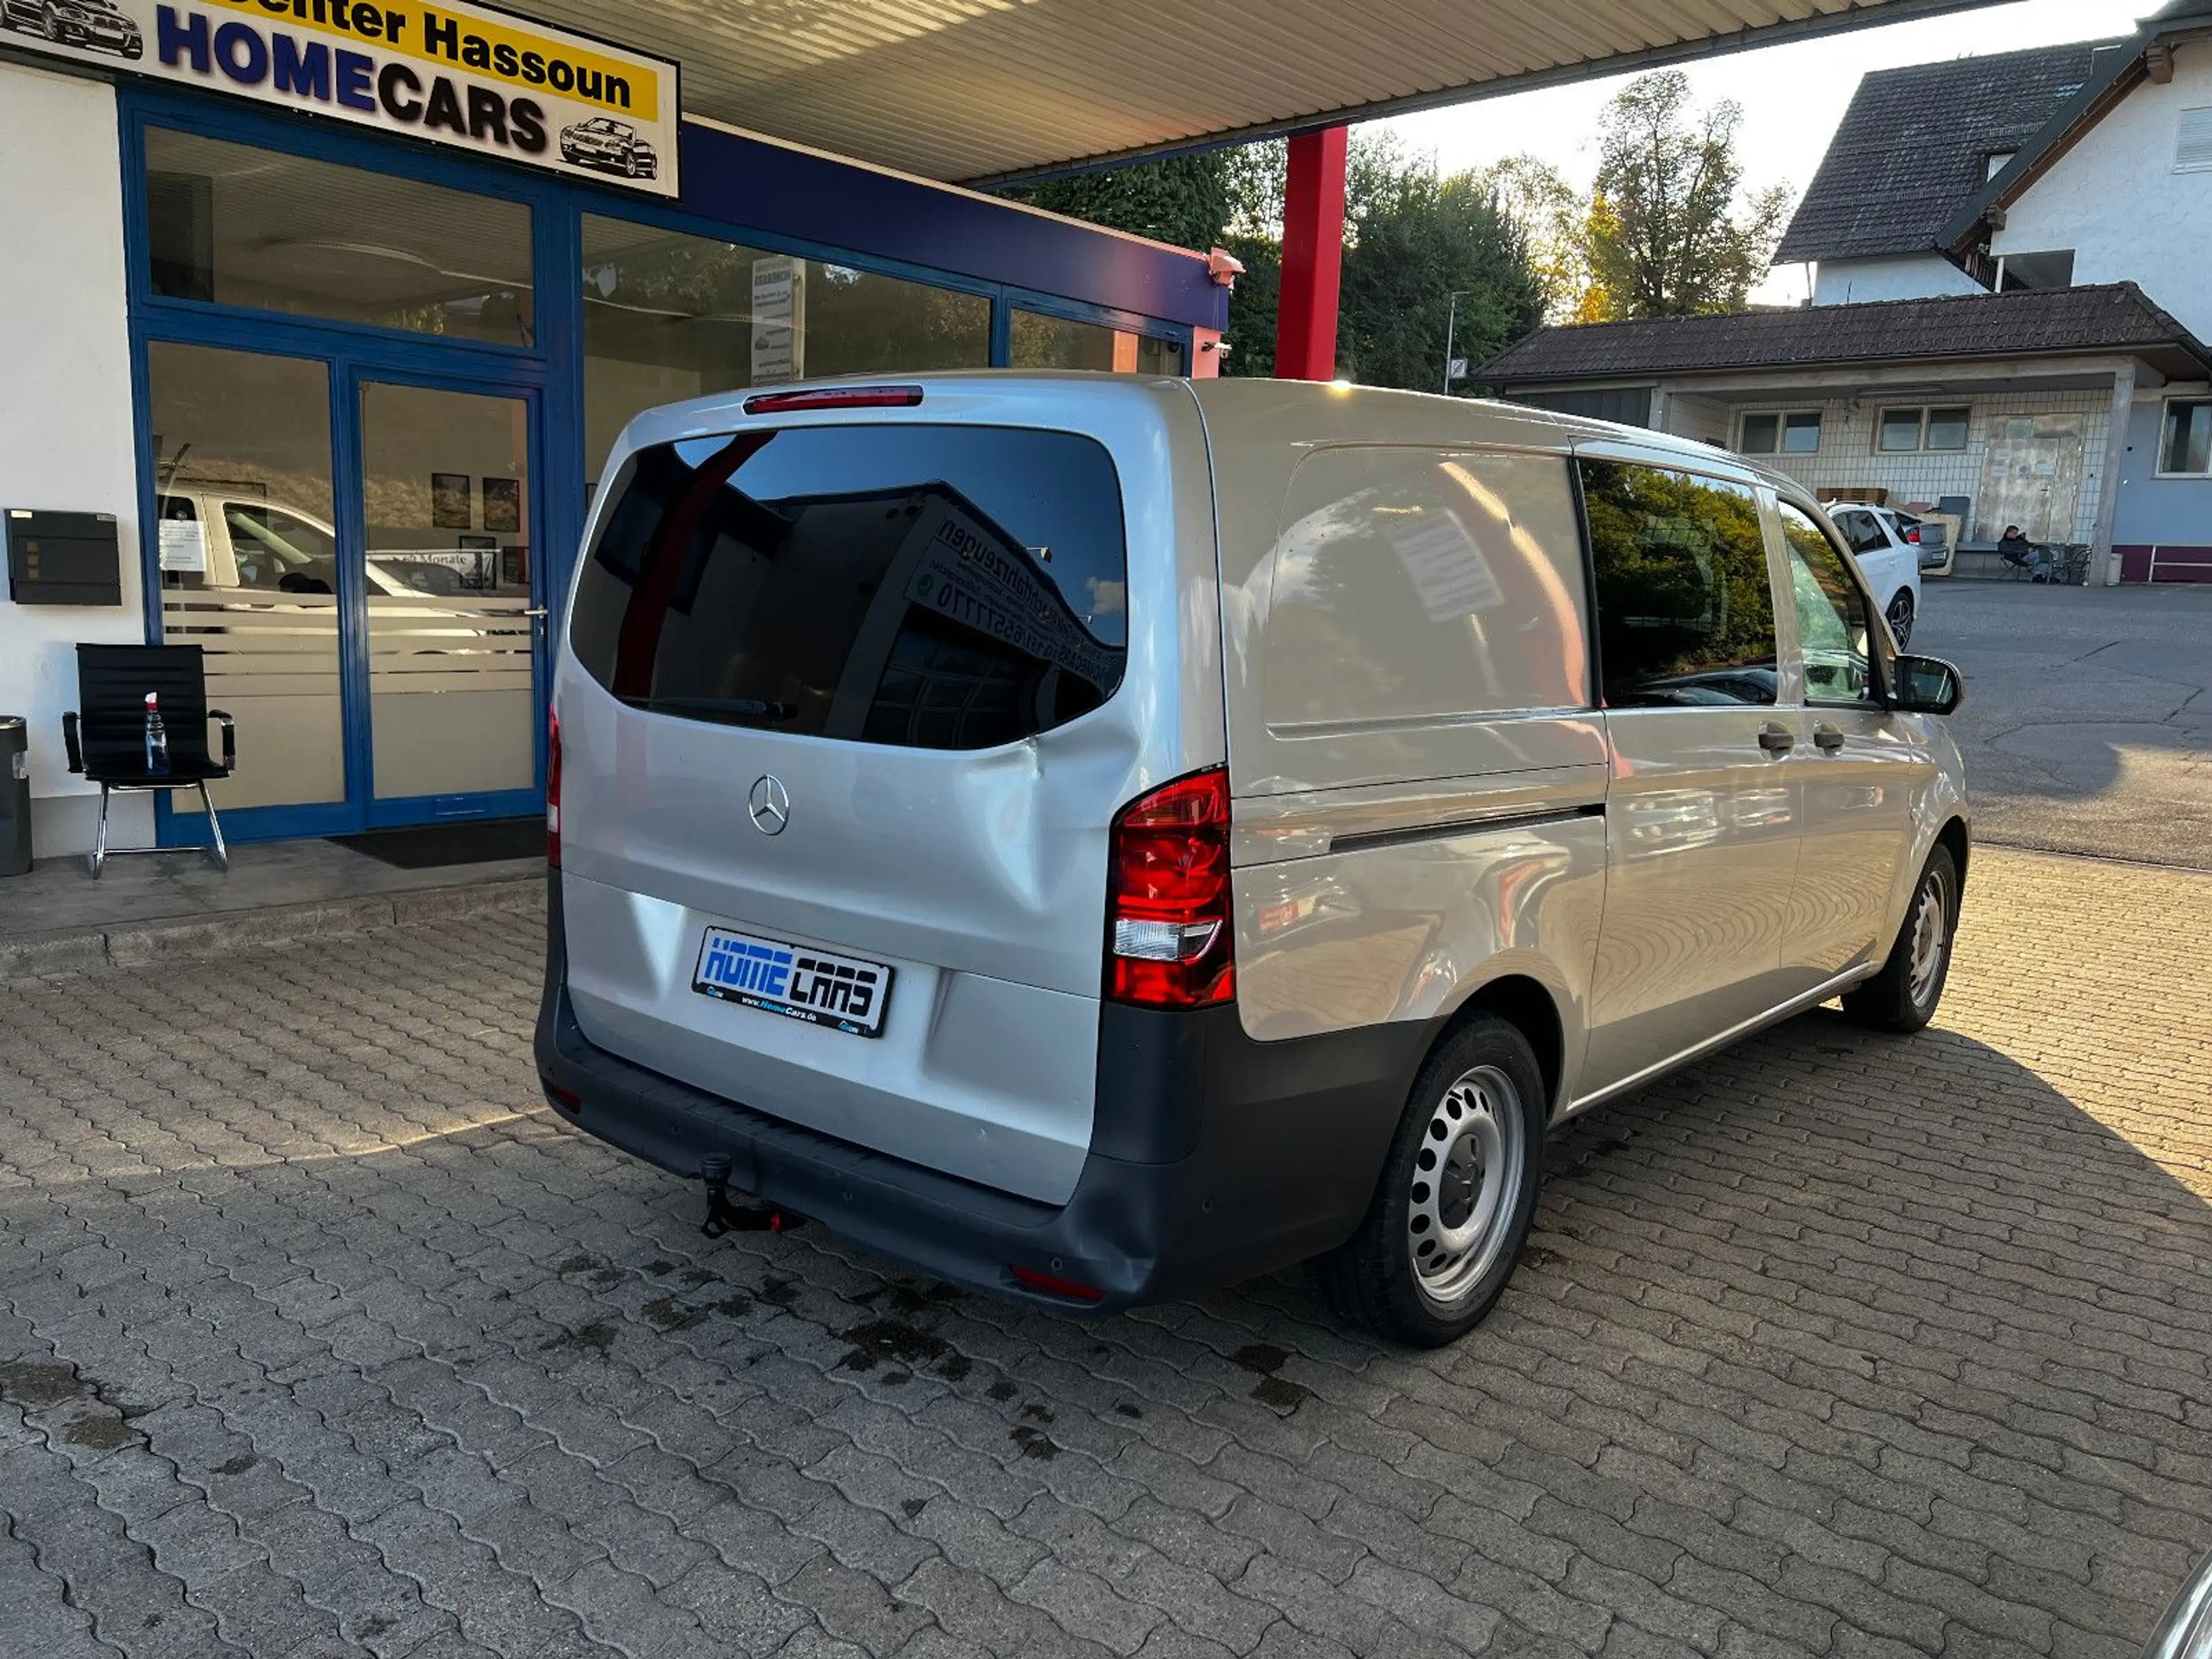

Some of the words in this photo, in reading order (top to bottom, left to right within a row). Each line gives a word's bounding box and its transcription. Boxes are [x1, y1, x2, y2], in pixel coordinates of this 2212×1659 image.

[157, 4, 547, 153] HOMECARS
[424, 12, 632, 109] Hassoun
[742, 996, 817, 1021] www.HomeCars.de
